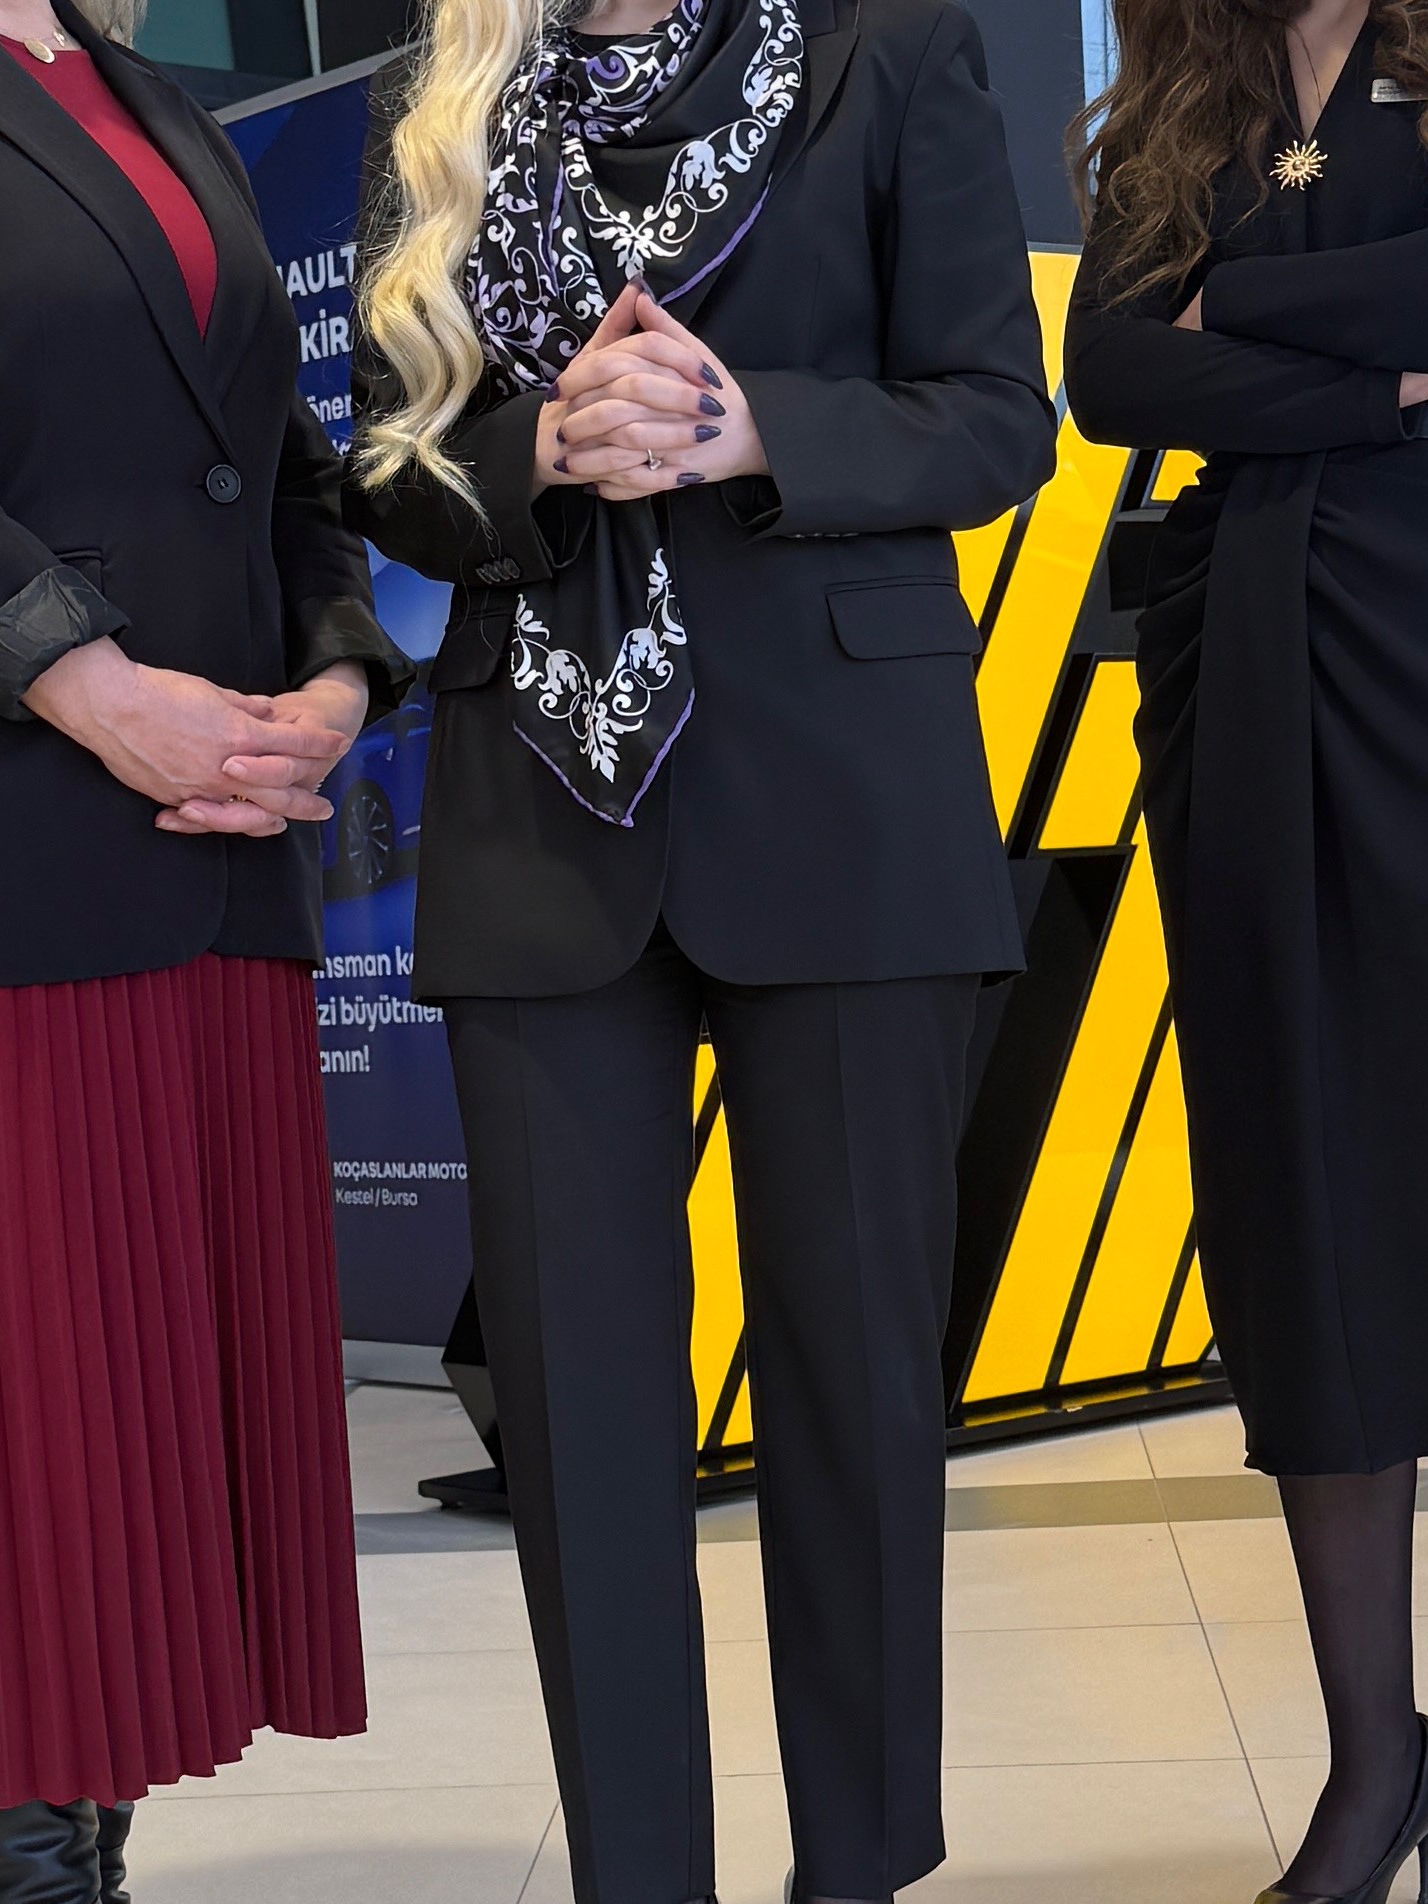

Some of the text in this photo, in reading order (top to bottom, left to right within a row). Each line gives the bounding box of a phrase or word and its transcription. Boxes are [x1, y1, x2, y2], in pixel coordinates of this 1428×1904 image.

[312, 953, 391, 979] nsman
[316, 996, 336, 1026] zi
[333, 1161, 427, 1182] KOÇASLANLAR
[335, 1186, 374, 1205] Kestel
[381, 1188, 418, 1206] Bursa
